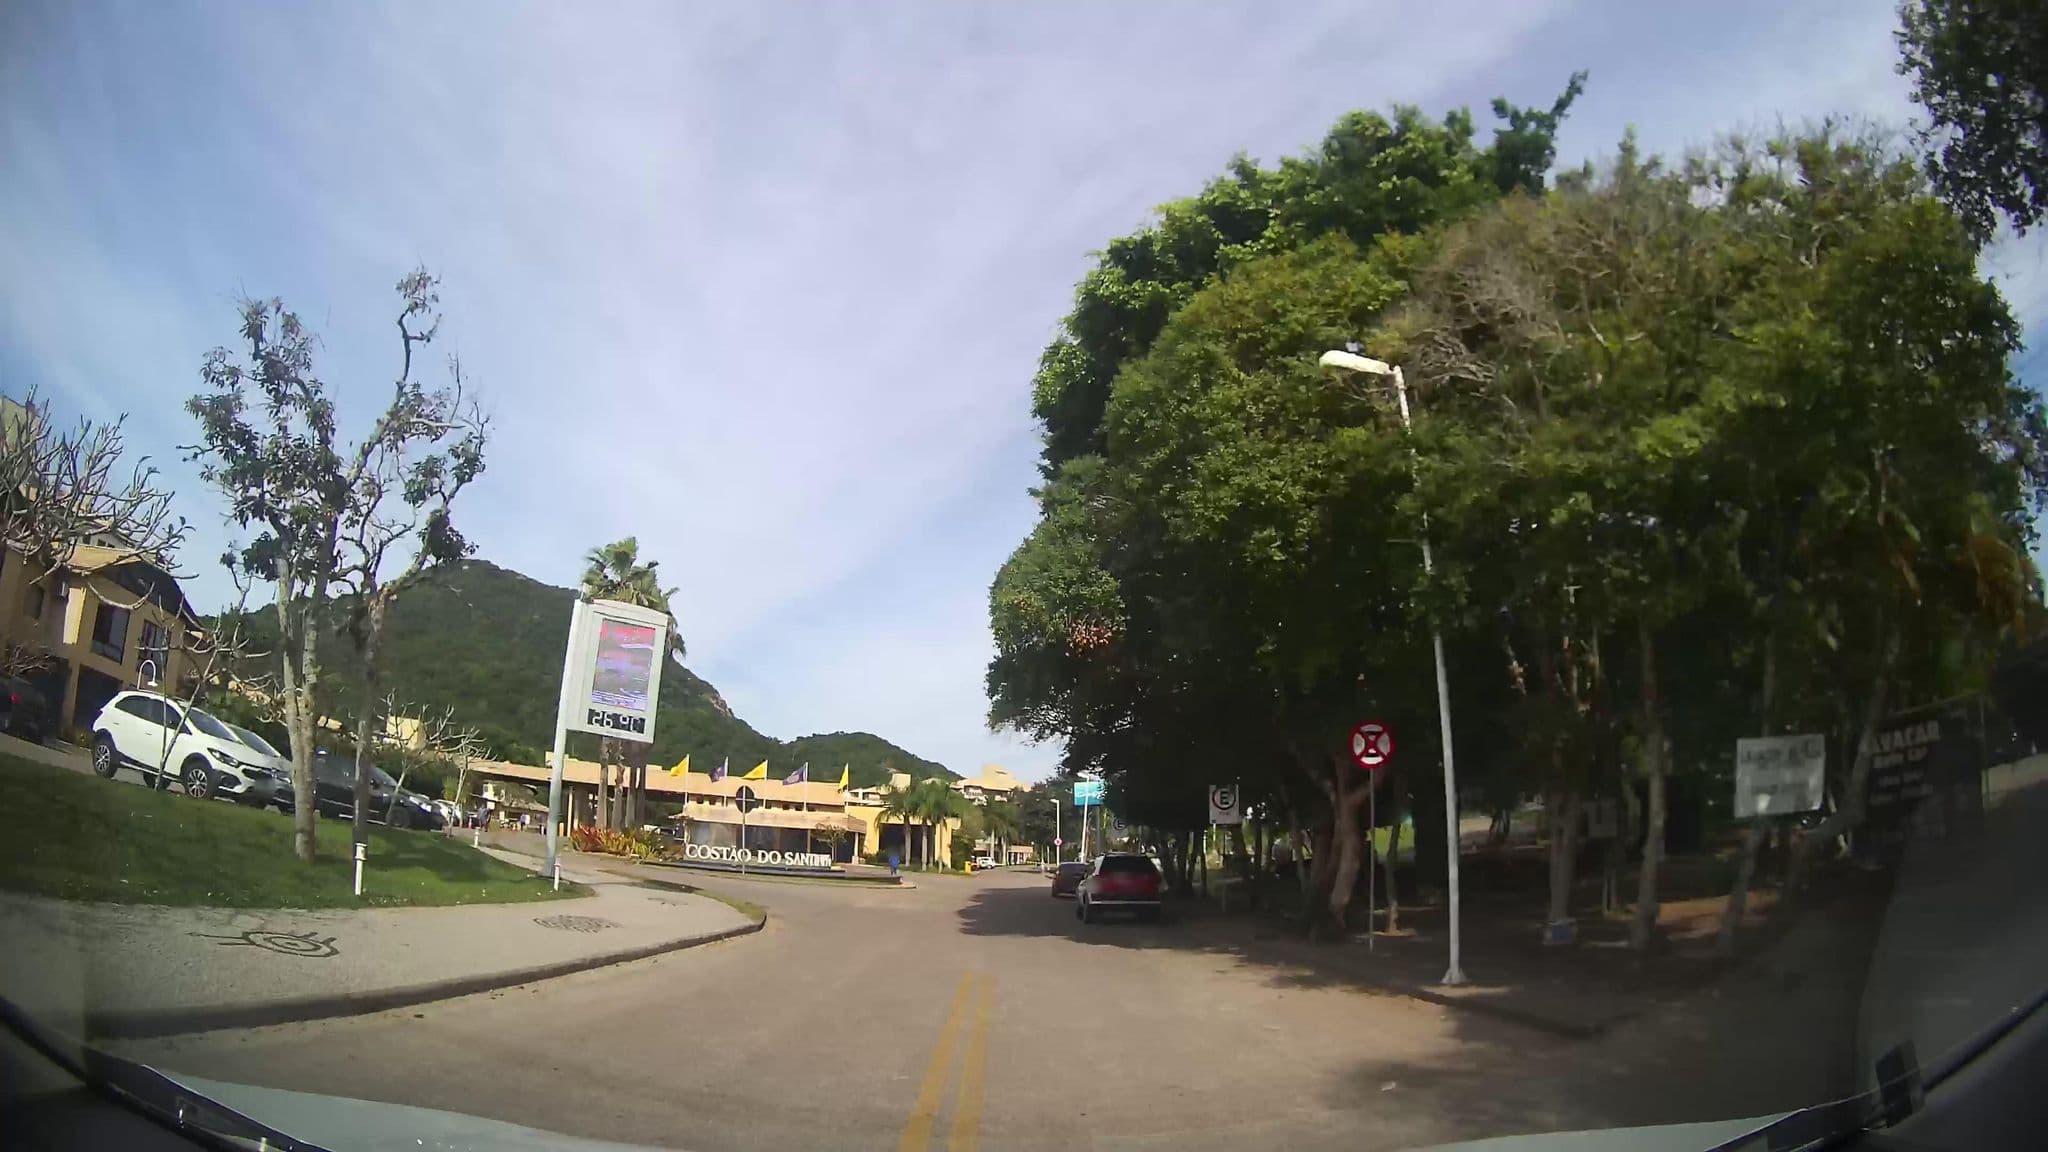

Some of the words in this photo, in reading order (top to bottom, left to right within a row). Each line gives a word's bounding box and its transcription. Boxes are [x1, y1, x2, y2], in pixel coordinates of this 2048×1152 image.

[1220, 791, 1230, 805] E
[685, 844, 751, 862] COSTÃO
[757, 849, 782, 865] DO
